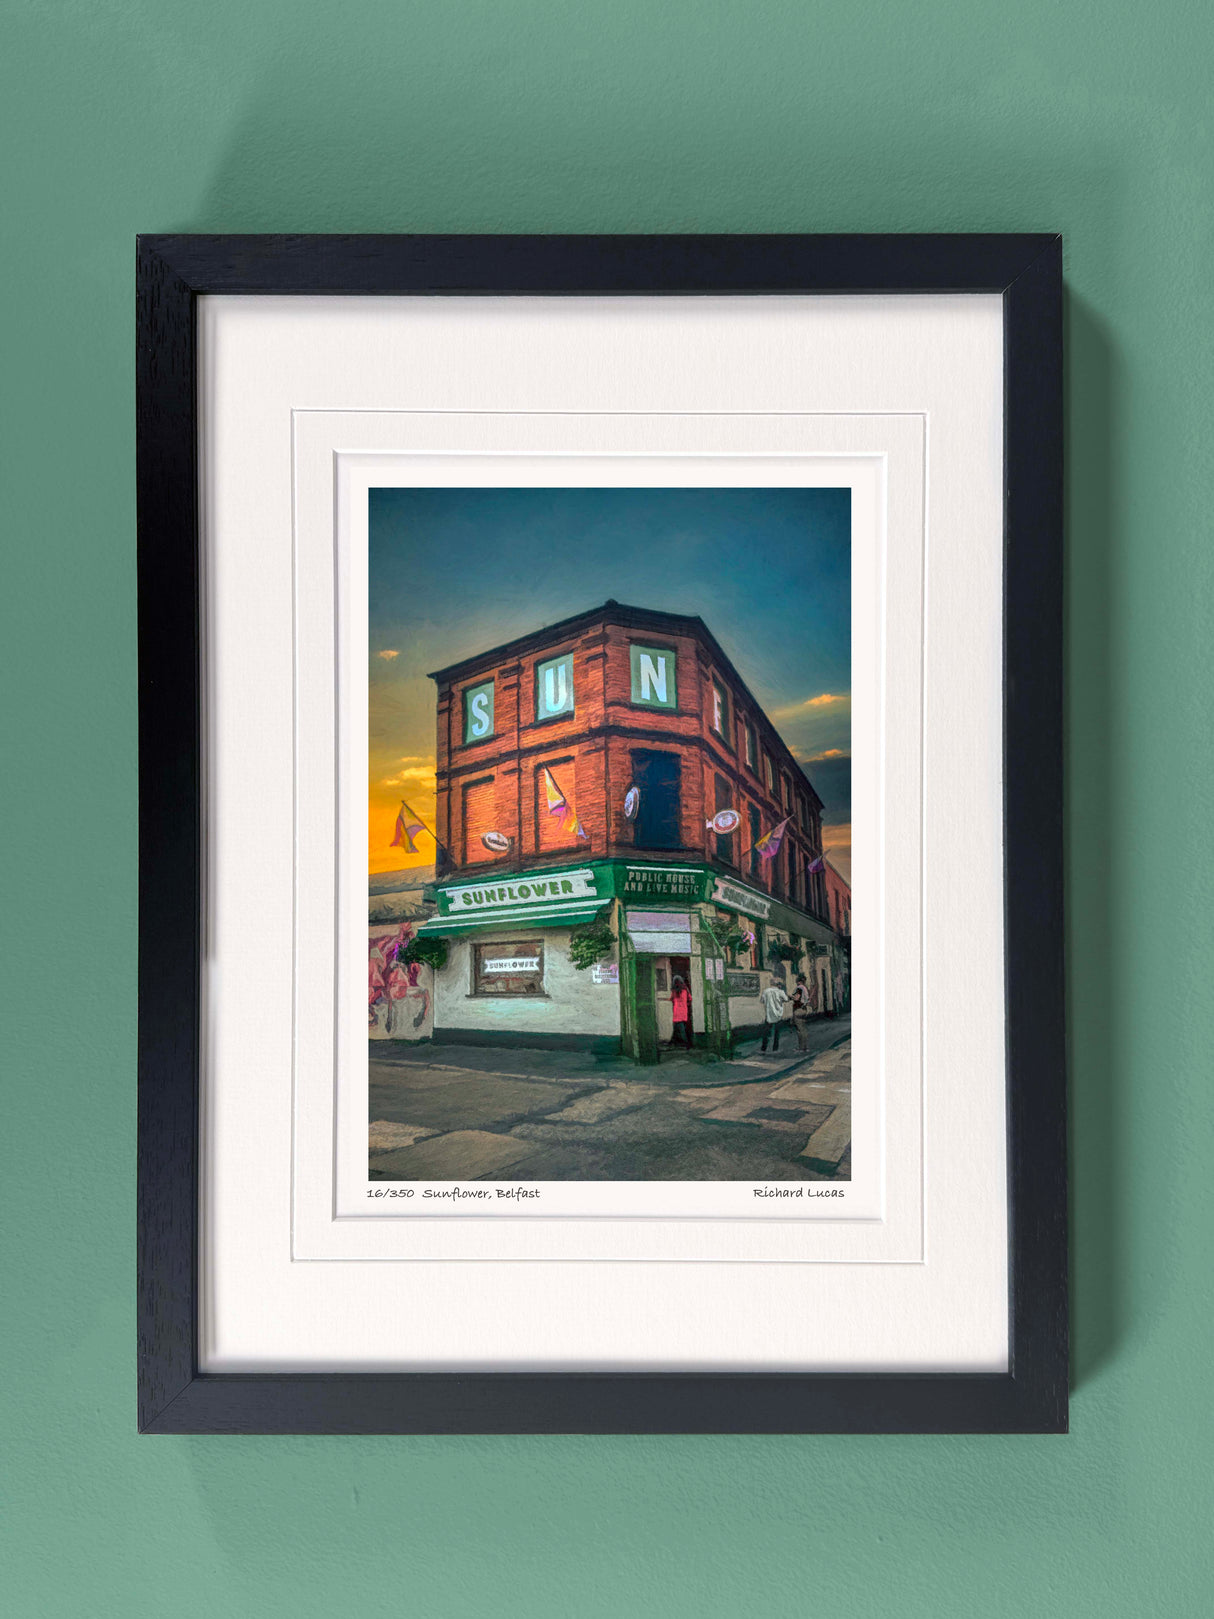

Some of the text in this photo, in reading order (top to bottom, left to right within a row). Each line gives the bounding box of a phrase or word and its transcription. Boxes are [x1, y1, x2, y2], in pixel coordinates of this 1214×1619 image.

[628, 871, 695, 884] PUBLIC HOUSE
[461, 879, 574, 906] SUNFLOWER
[624, 882, 699, 895] AND LIVE MUSIC
[366, 1186, 541, 1201] 16/350 Sunflower, Belfast
[753, 1186, 845, 1198] Richard Lucas
